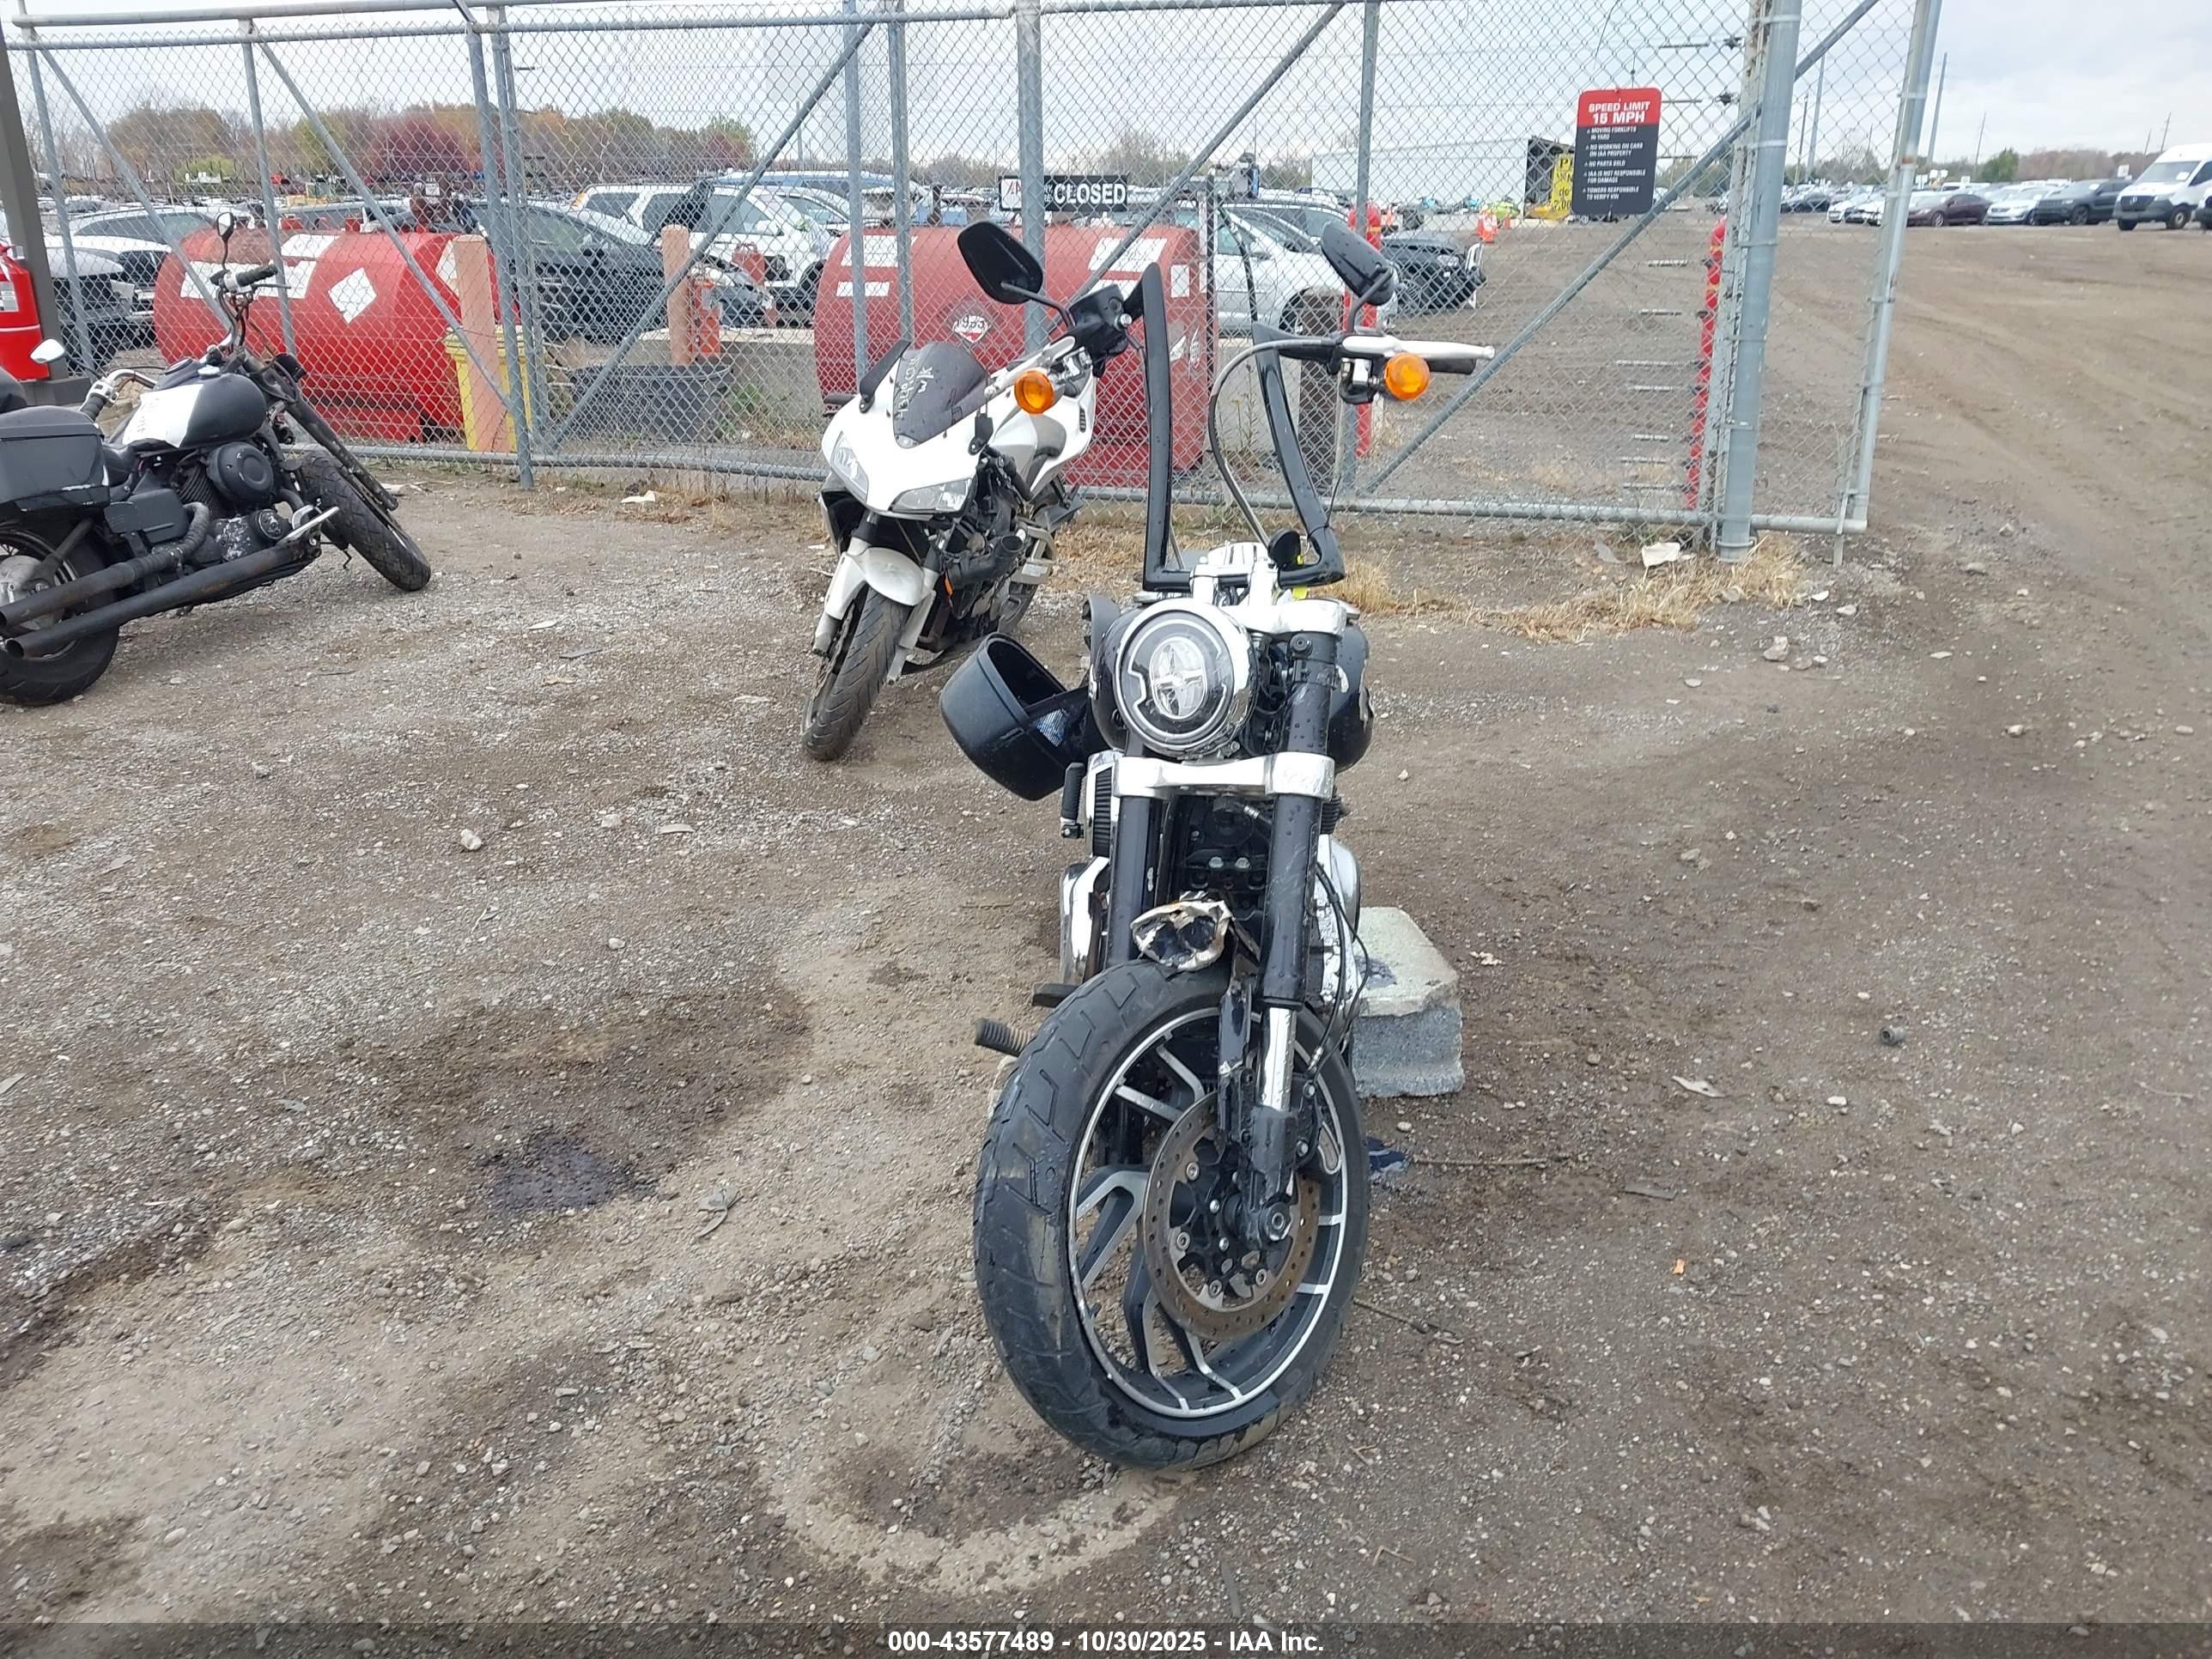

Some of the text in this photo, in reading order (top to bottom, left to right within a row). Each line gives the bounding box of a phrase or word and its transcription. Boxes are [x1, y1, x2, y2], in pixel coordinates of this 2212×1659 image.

[1588, 101, 1650, 113] SPEED LIMIT
[1593, 111, 1645, 125] 15 MPH
[1054, 183, 1126, 204] CLOSED
